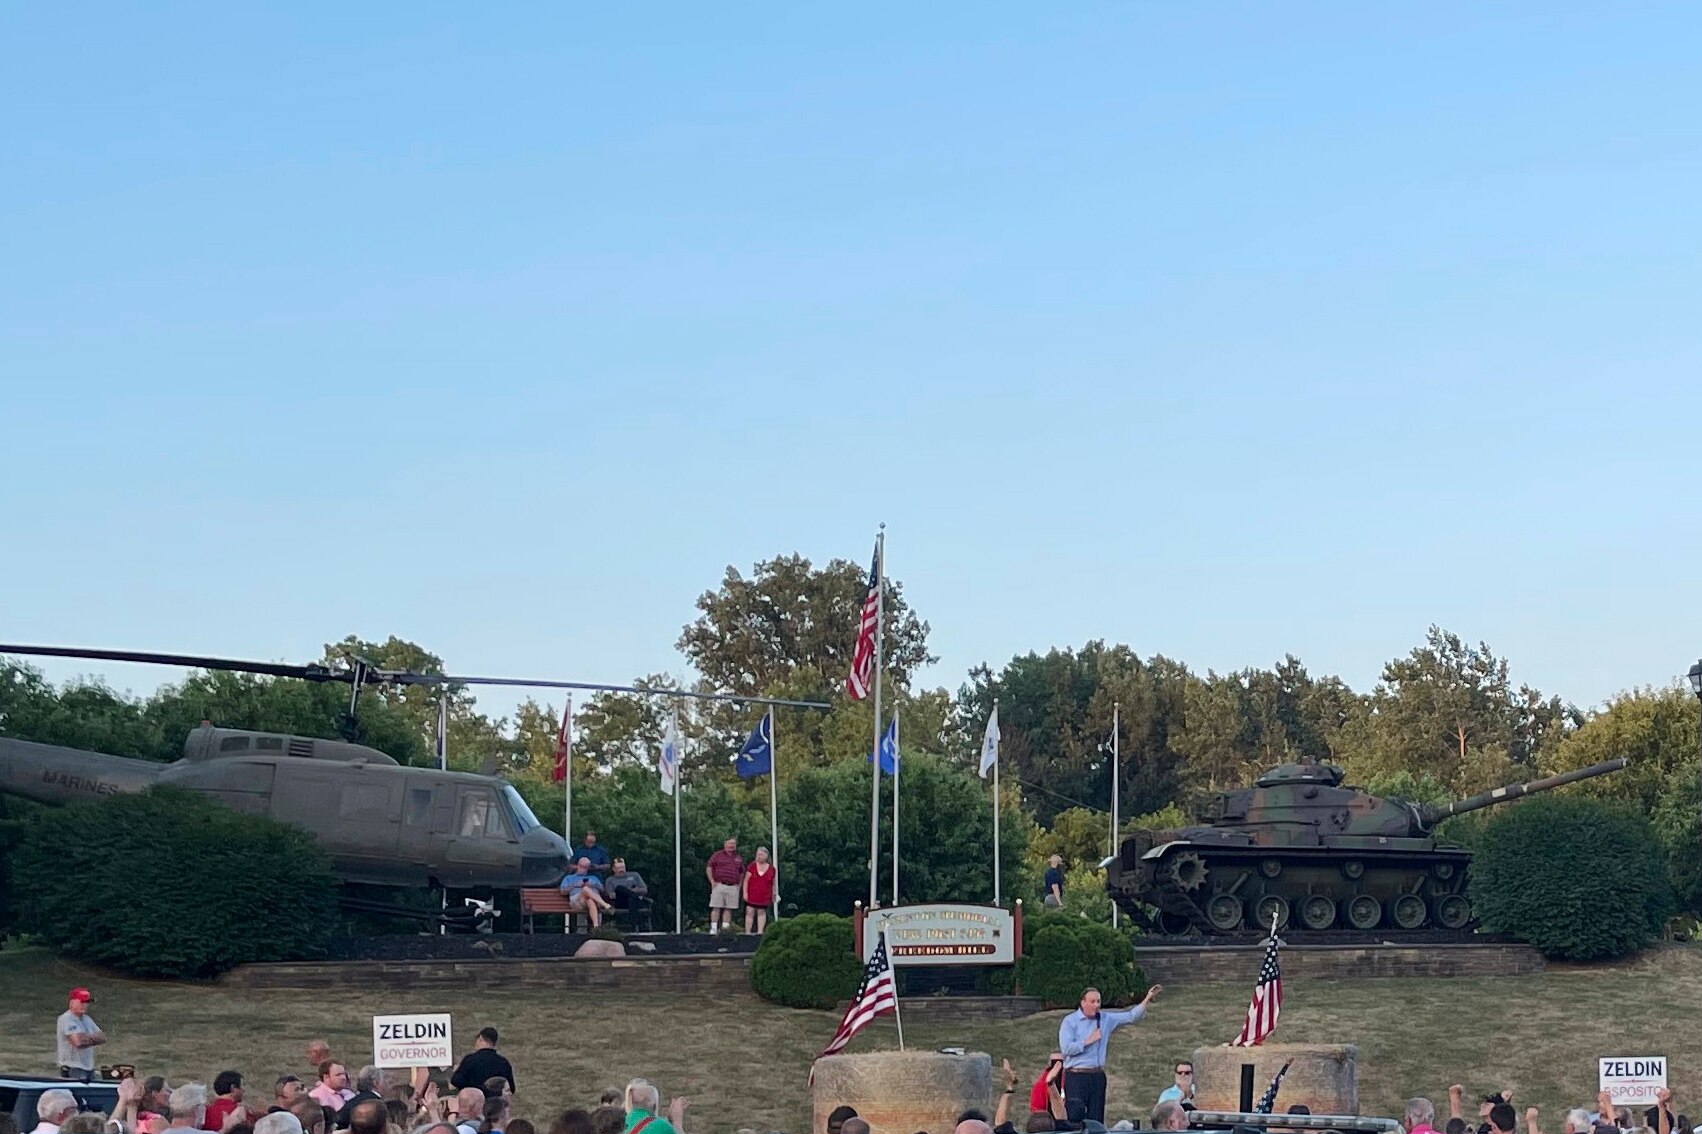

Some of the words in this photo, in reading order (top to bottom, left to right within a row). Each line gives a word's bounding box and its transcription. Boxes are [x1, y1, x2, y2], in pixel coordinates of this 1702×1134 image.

[379, 1022, 446, 1040] ZELDIN
[380, 1047, 447, 1060] GOVERNOR
[1603, 1061, 1662, 1077] ZELDIN
